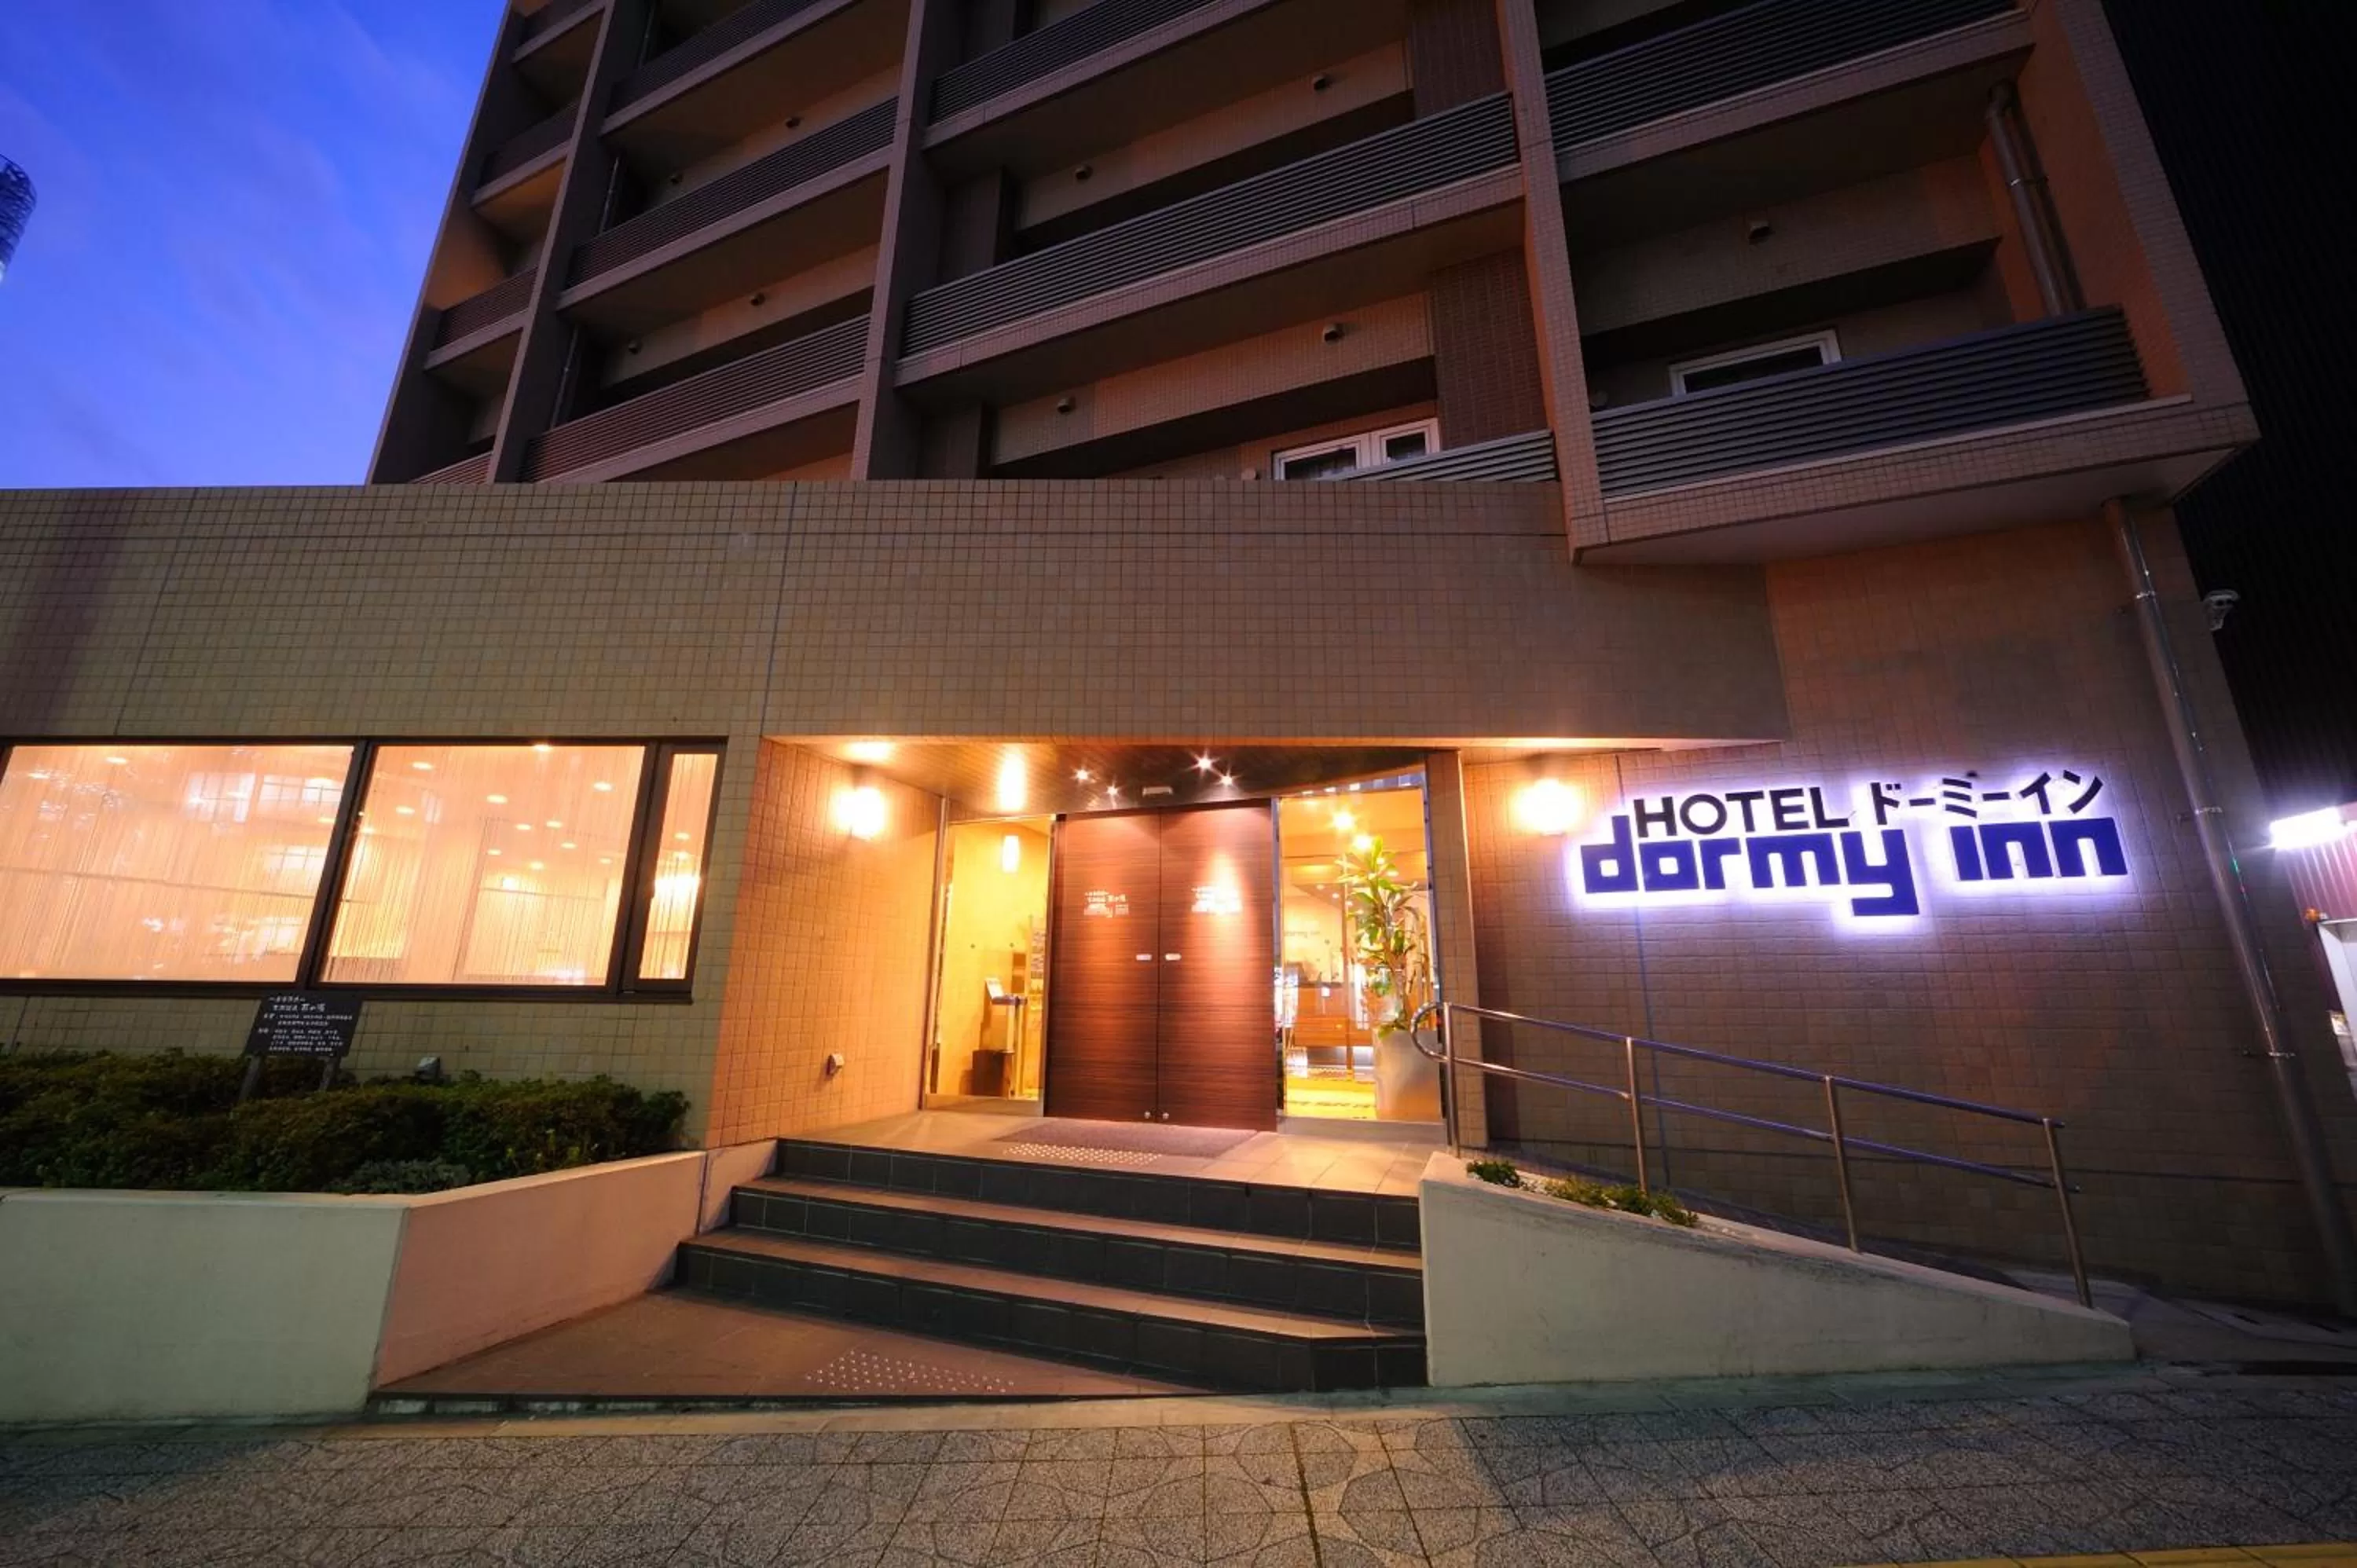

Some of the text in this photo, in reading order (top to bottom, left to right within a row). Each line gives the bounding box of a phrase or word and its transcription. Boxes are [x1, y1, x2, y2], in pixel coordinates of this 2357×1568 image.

[1633, 786, 1848, 837] HOTEL
[1871, 770, 2103, 825] ドーミーイン
[1580, 815, 2128, 917] dormy inn
